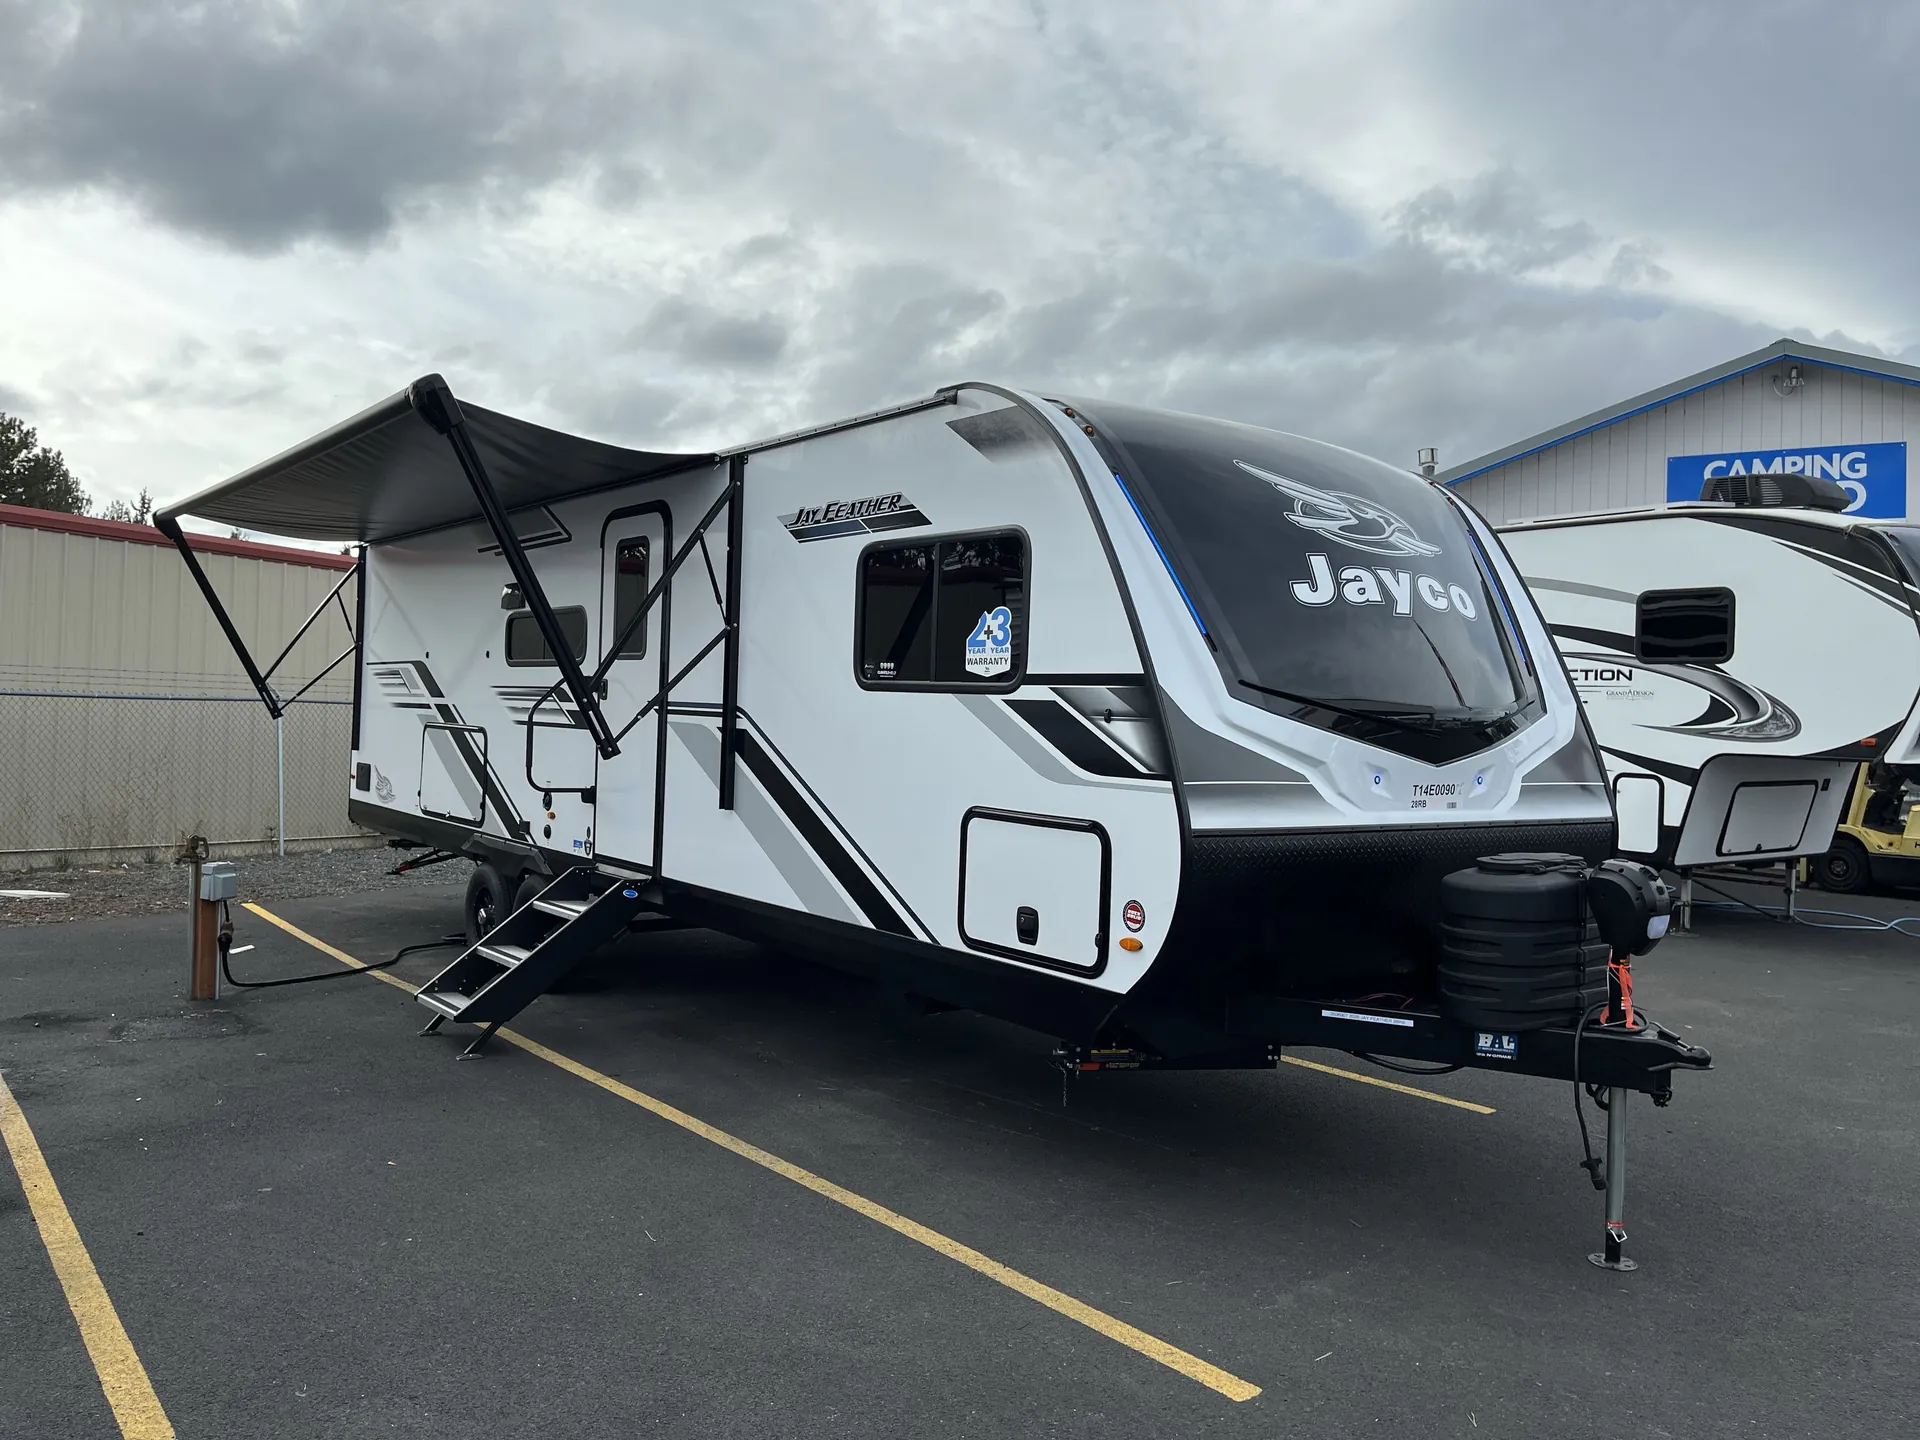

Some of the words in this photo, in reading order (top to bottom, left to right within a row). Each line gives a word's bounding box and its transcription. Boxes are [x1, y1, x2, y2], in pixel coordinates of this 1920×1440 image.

[1703, 451, 1868, 480] CAMPING
[787, 506, 822, 528] JAY
[821, 492, 902, 522] FEATHER
[1289, 552, 1478, 621] Jayco
[967, 657, 1009, 665] WARRANTY
